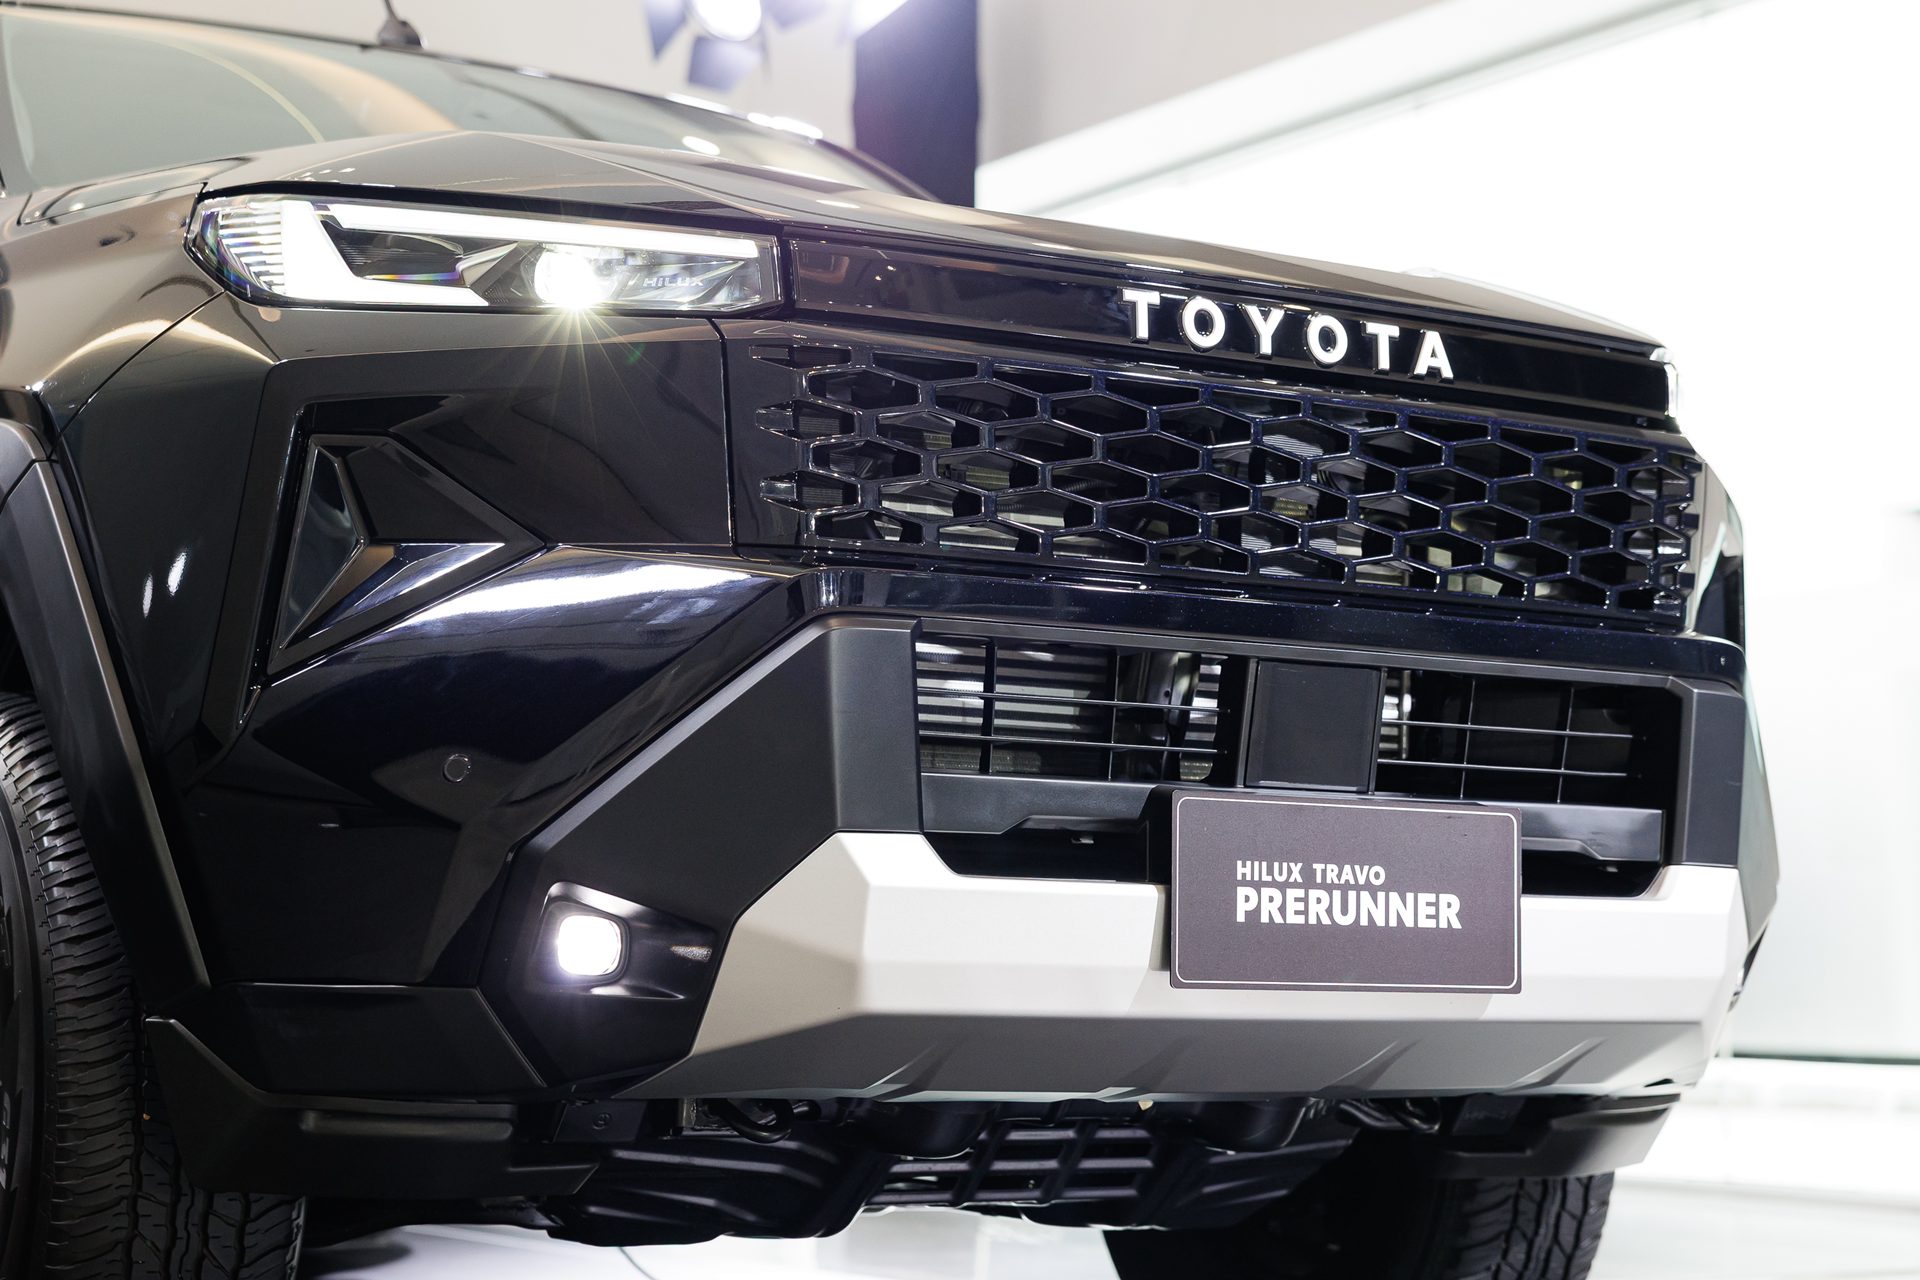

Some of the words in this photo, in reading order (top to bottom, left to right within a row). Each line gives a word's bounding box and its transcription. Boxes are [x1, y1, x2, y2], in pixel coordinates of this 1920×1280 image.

[642, 277, 704, 287] HILUX
[1121, 287, 1455, 382] TOYOTA
[1236, 860, 1304, 884] HILUX
[1312, 863, 1386, 887] TRAVO
[1236, 886, 1463, 930] PRERUNNER
